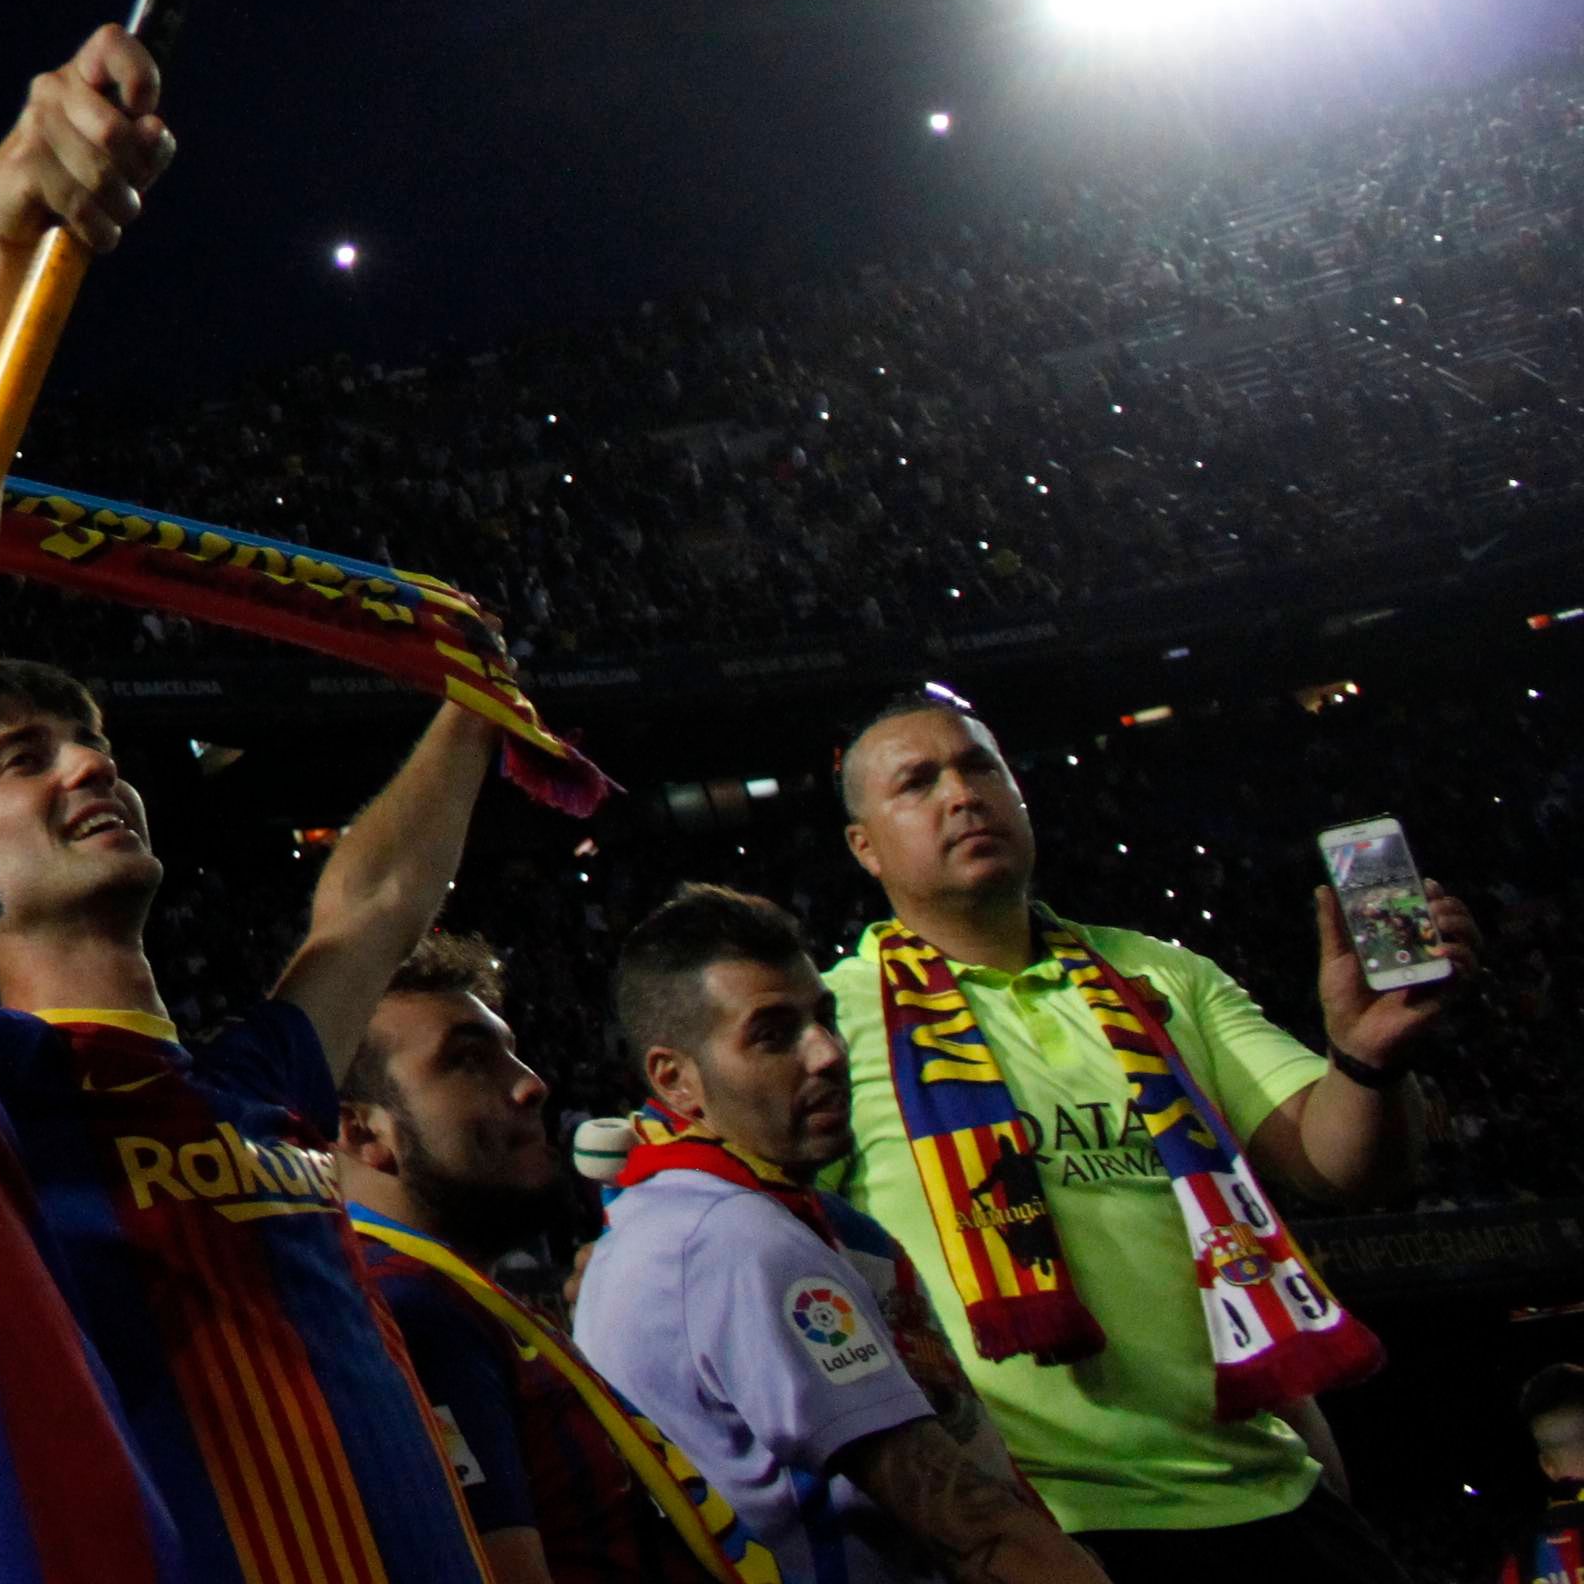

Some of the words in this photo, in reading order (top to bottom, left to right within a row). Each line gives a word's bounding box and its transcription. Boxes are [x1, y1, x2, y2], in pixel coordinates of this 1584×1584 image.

[1015, 1097, 1154, 1166] QATA
[1061, 1147, 1169, 1187] AIRWA
[821, 1343, 879, 1372] LaLiga
